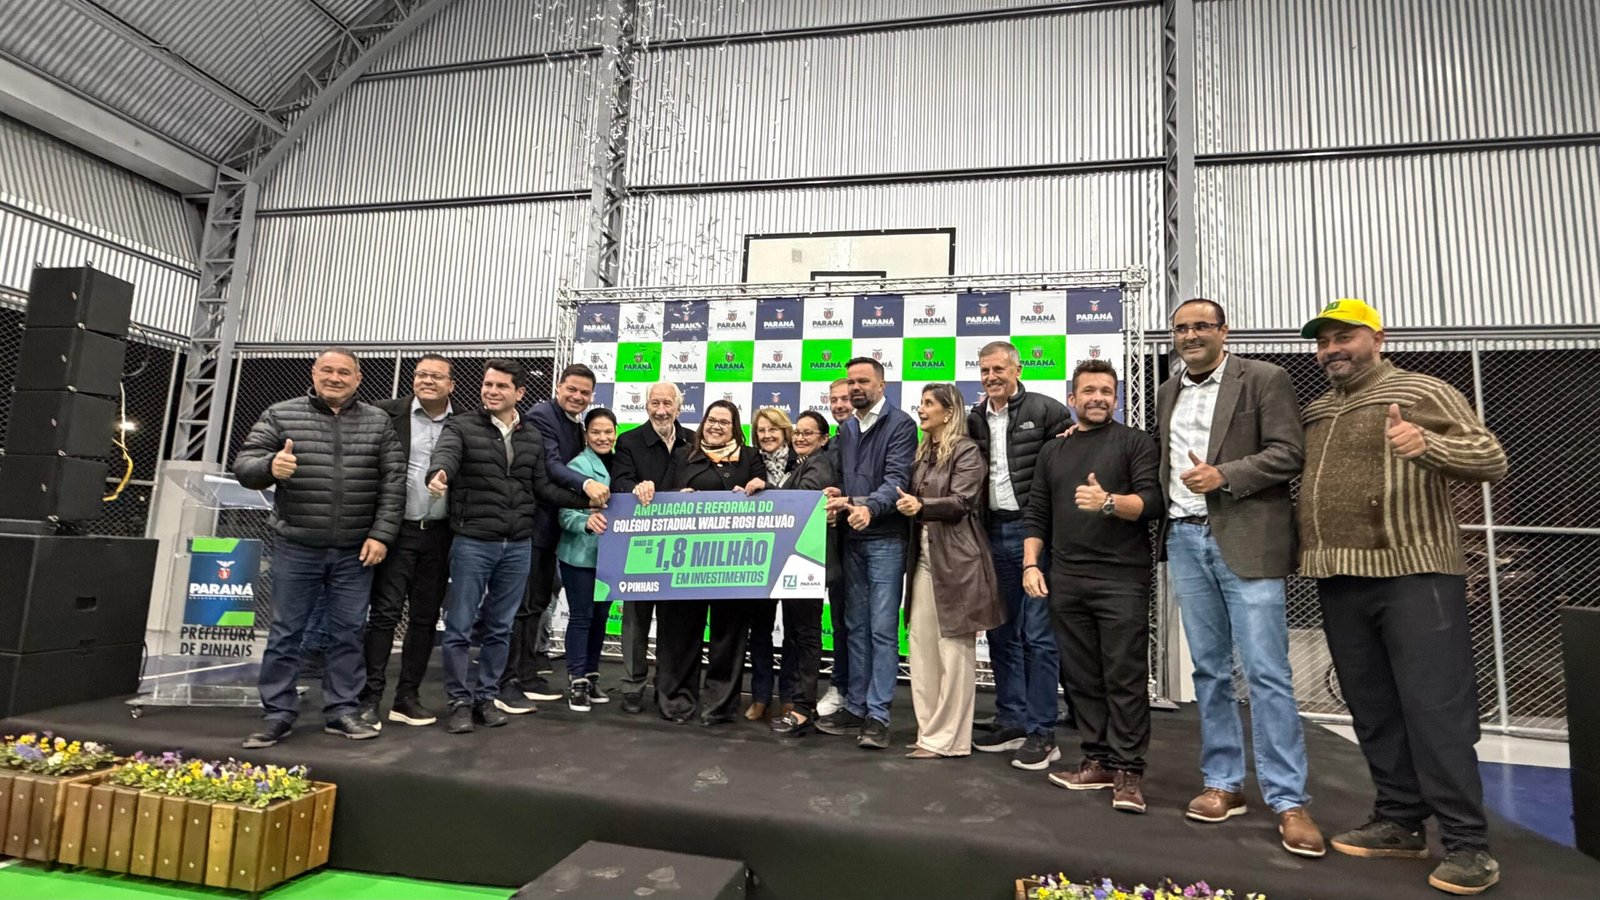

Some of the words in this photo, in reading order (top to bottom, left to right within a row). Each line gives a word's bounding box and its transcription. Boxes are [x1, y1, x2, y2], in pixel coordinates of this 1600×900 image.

[965, 315, 1000, 323] PARANÁ
[1076, 312, 1113, 320] PARANÁ
[633, 501, 694, 516] AMPLIAÇÃO
[695, 502, 704, 514] E
[704, 501, 756, 514] REFORMA
[758, 500, 774, 513] DO
[613, 518, 651, 533] COLÉGIO
[651, 517, 697, 532] ESTADUAL
[698, 515, 731, 530] WALDE
[732, 515, 756, 529] ROSI
[757, 514, 795, 529] GALVÃO
[655, 537, 688, 571] 1,8
[690, 537, 769, 568] MILHÃO
[676, 572, 691, 585] EM
[691, 571, 765, 584] INVESTIMENTOS
[189, 583, 254, 595] PARANÁ
[627, 582, 660, 593] PINHAIS
[181, 626, 256, 641] PREFEITURA
[181, 642, 196, 655] DE
[200, 643, 253, 657] PINHAIS
